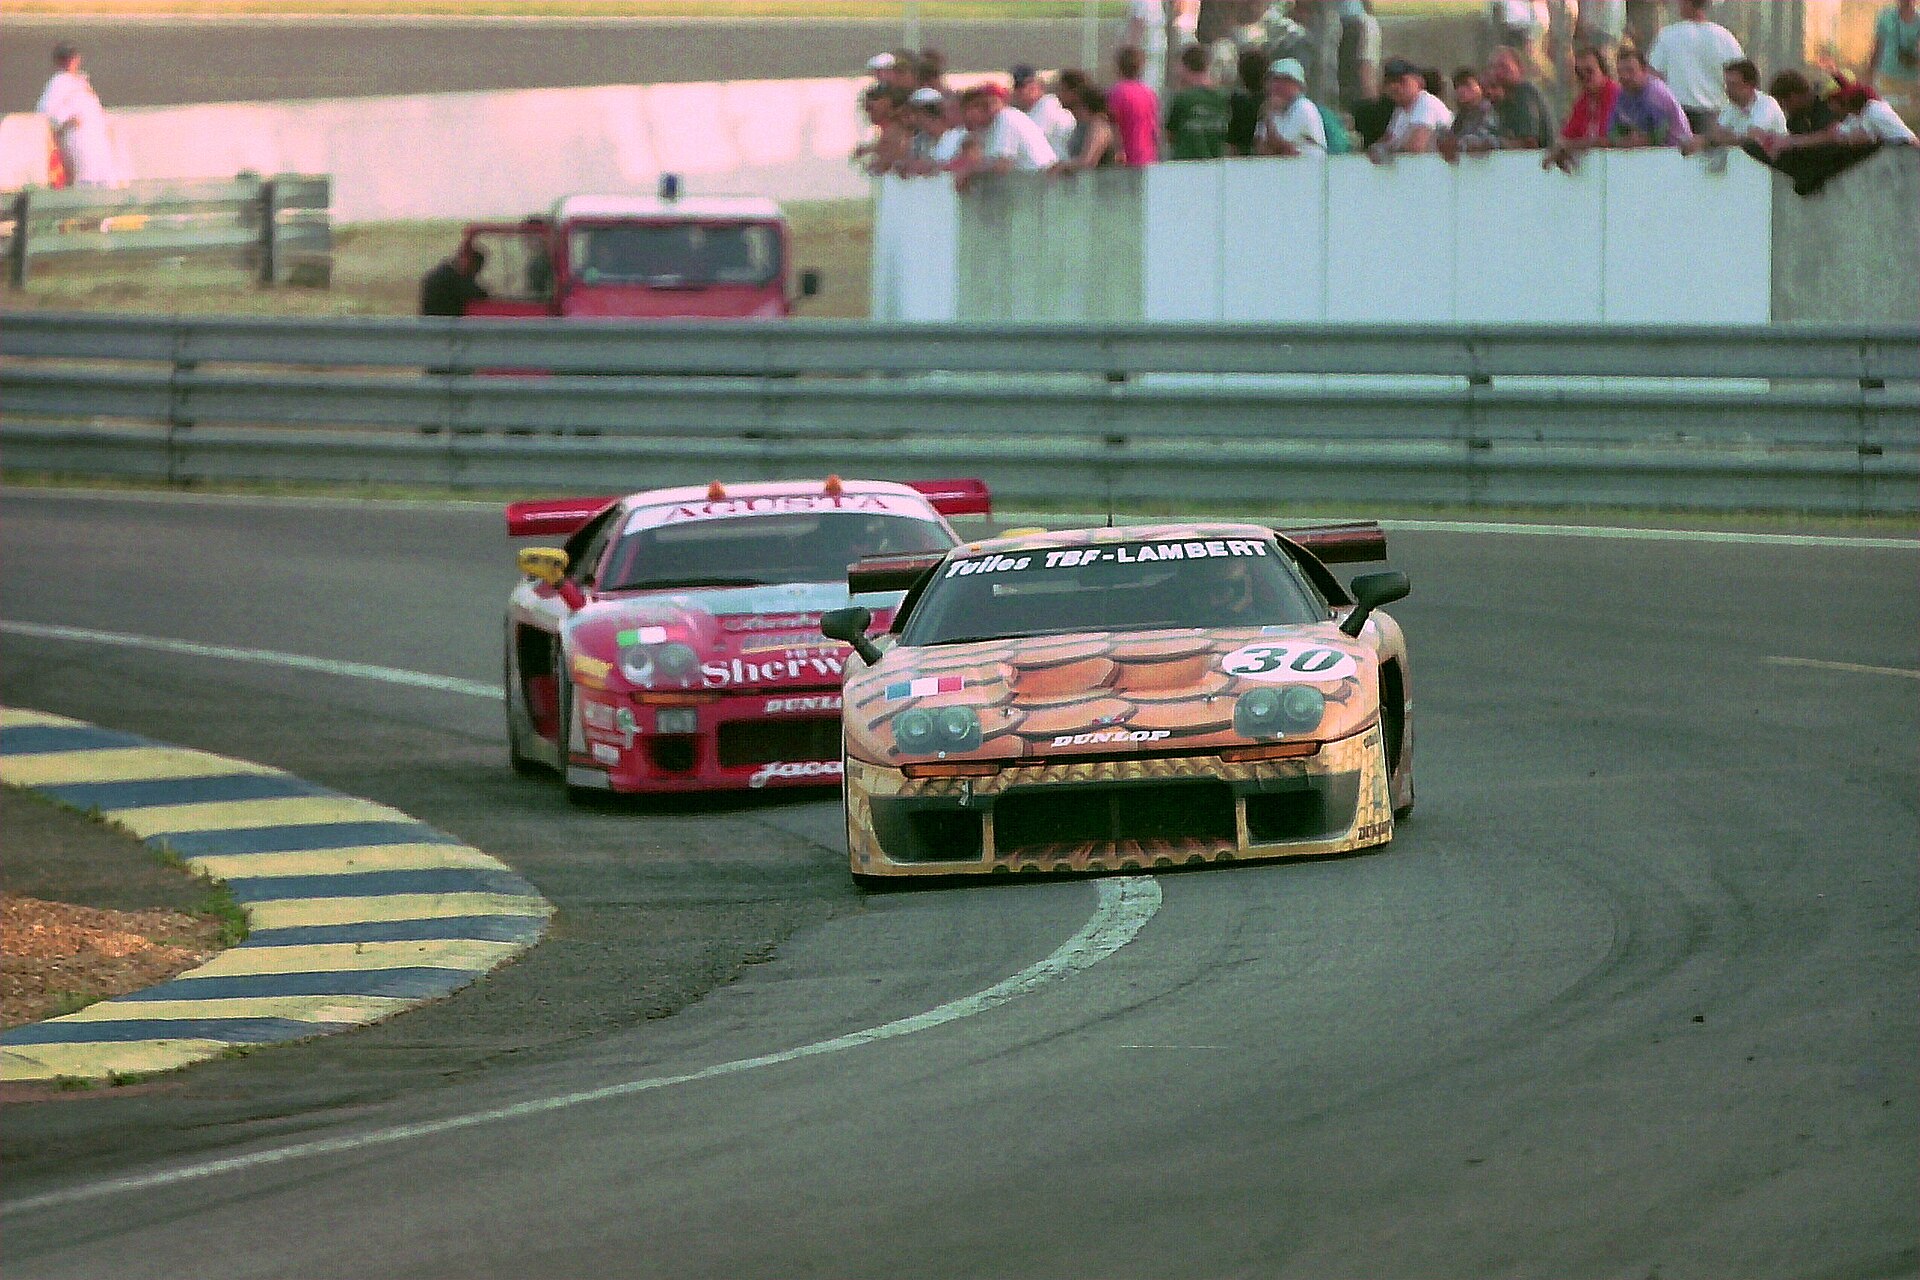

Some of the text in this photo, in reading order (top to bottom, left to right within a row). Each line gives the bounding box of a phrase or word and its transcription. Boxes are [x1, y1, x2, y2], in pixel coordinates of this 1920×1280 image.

[1045, 541, 1268, 568] TBF-LAMBERT
[1232, 647, 1343, 673] 30
[1050, 730, 1171, 748] DUNLOP
